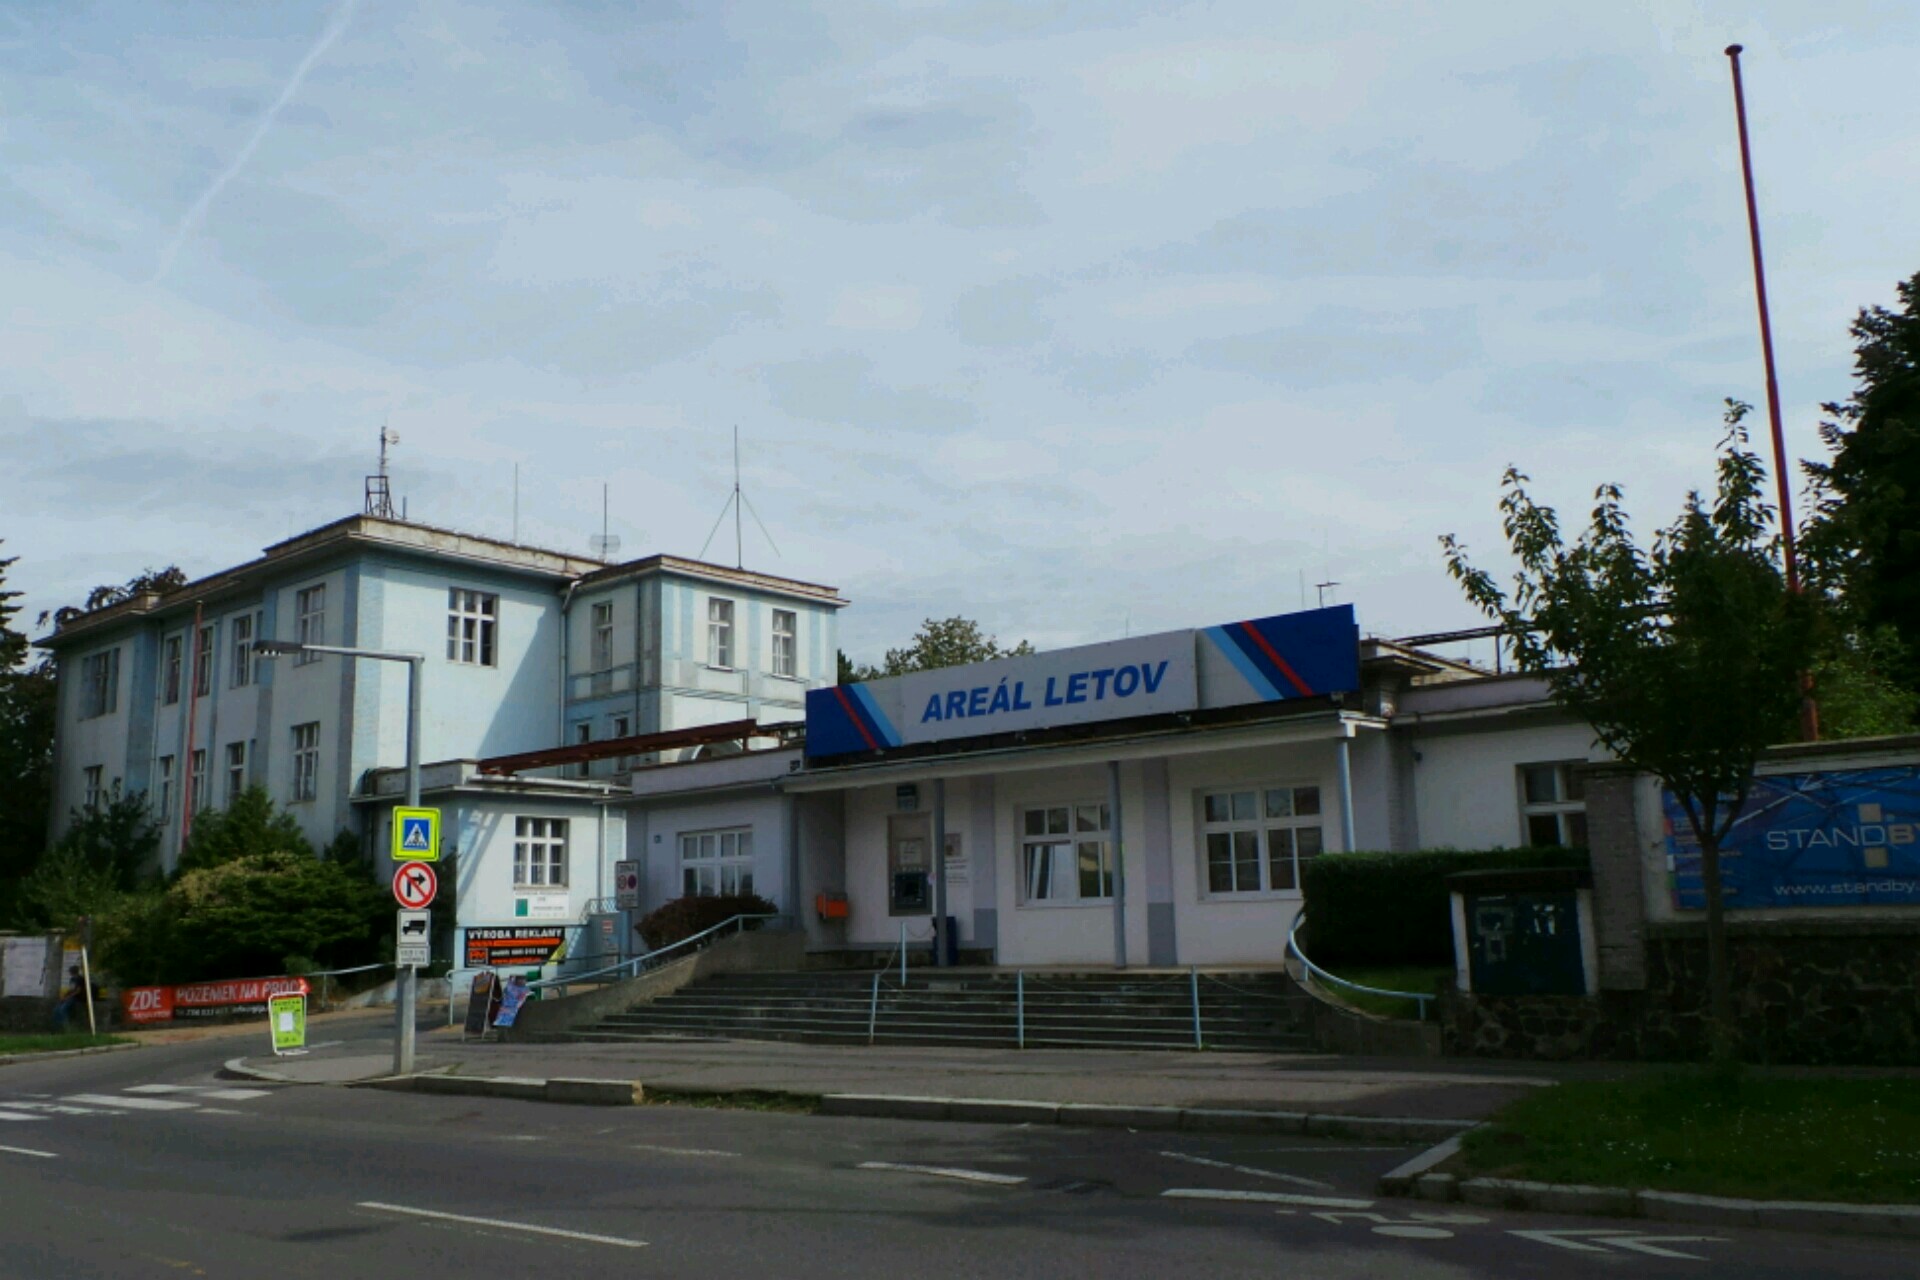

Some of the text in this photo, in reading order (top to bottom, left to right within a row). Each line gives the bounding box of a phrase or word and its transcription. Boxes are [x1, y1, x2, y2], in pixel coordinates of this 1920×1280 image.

[920, 660, 1169, 724] AREÁL LETOV
[129, 989, 162, 1011] ZDE
[176, 984, 239, 1004] POZEMEK
[240, 982, 258, 999] NA
